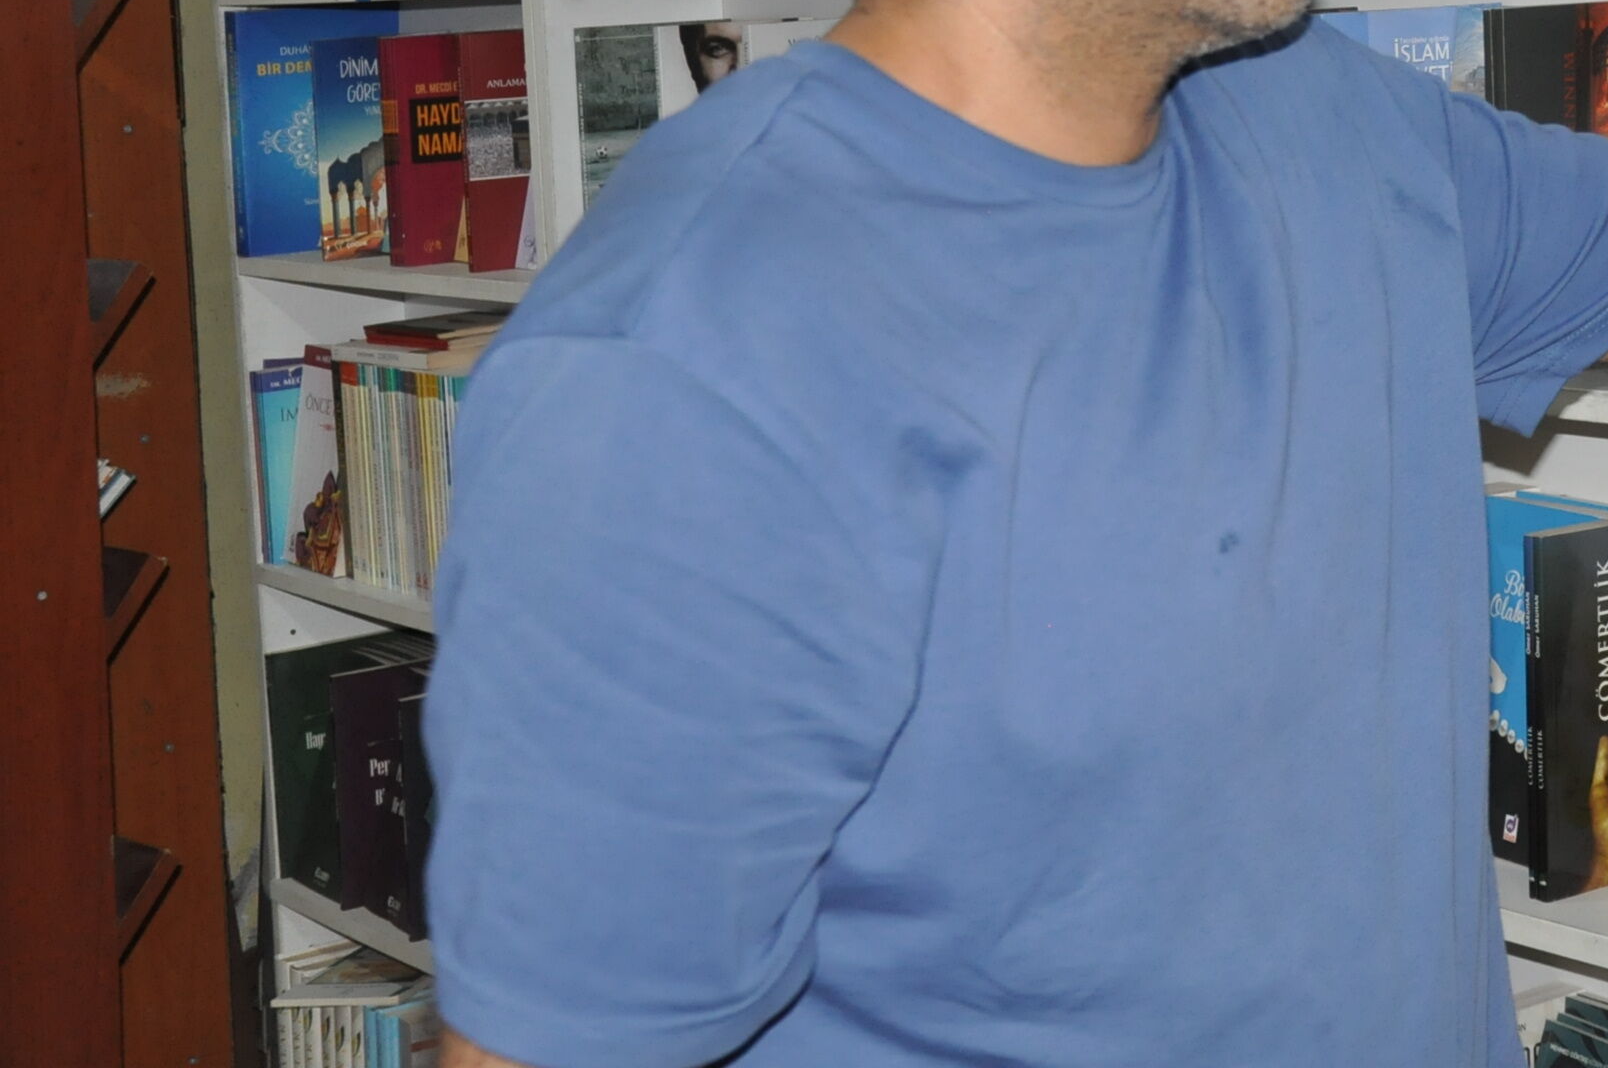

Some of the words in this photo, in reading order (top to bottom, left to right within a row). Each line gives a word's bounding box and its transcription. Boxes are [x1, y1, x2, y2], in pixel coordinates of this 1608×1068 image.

[1394, 38, 1449, 62] İSLAM
[257, 61, 281, 76] BİR
[347, 82, 380, 103] GÖRE
